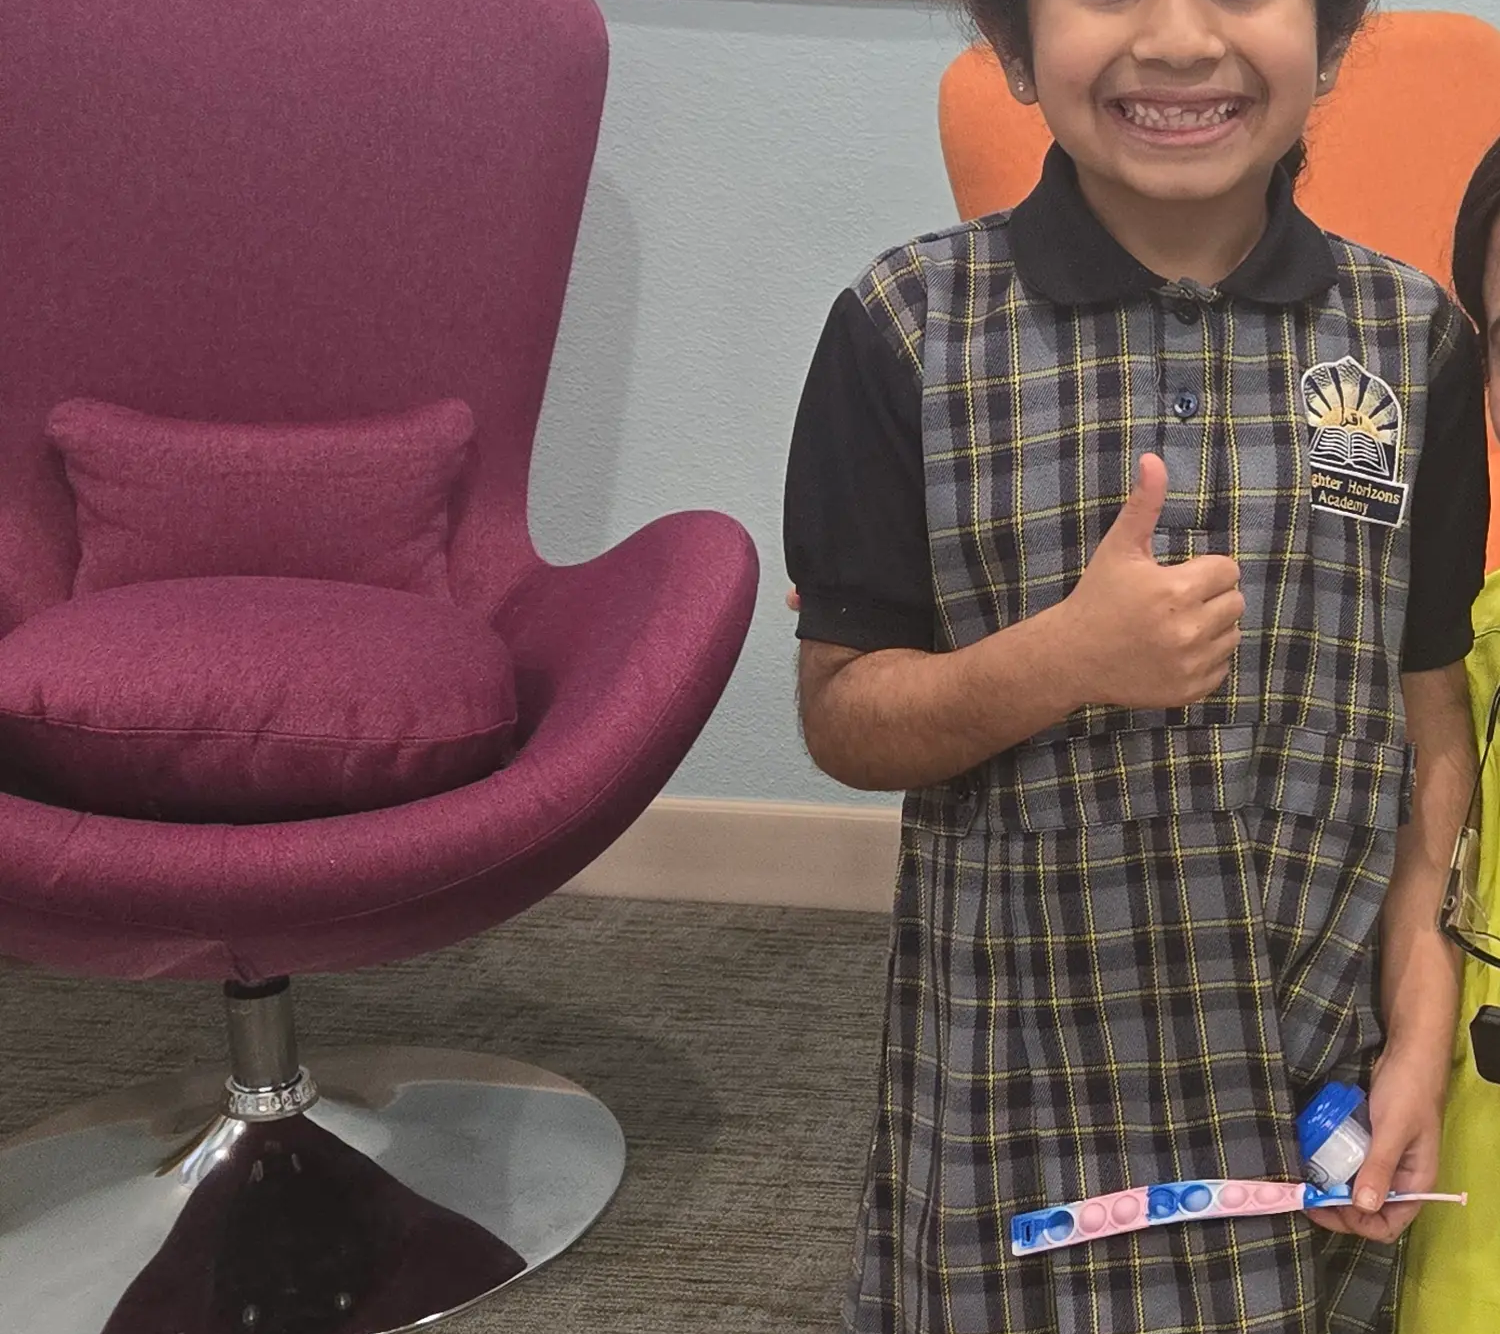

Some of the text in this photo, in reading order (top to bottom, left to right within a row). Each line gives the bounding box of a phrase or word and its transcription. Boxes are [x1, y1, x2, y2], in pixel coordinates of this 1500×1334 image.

[1311, 473, 1401, 505] ghter Horizons
[1318, 491, 1369, 515] Academy
